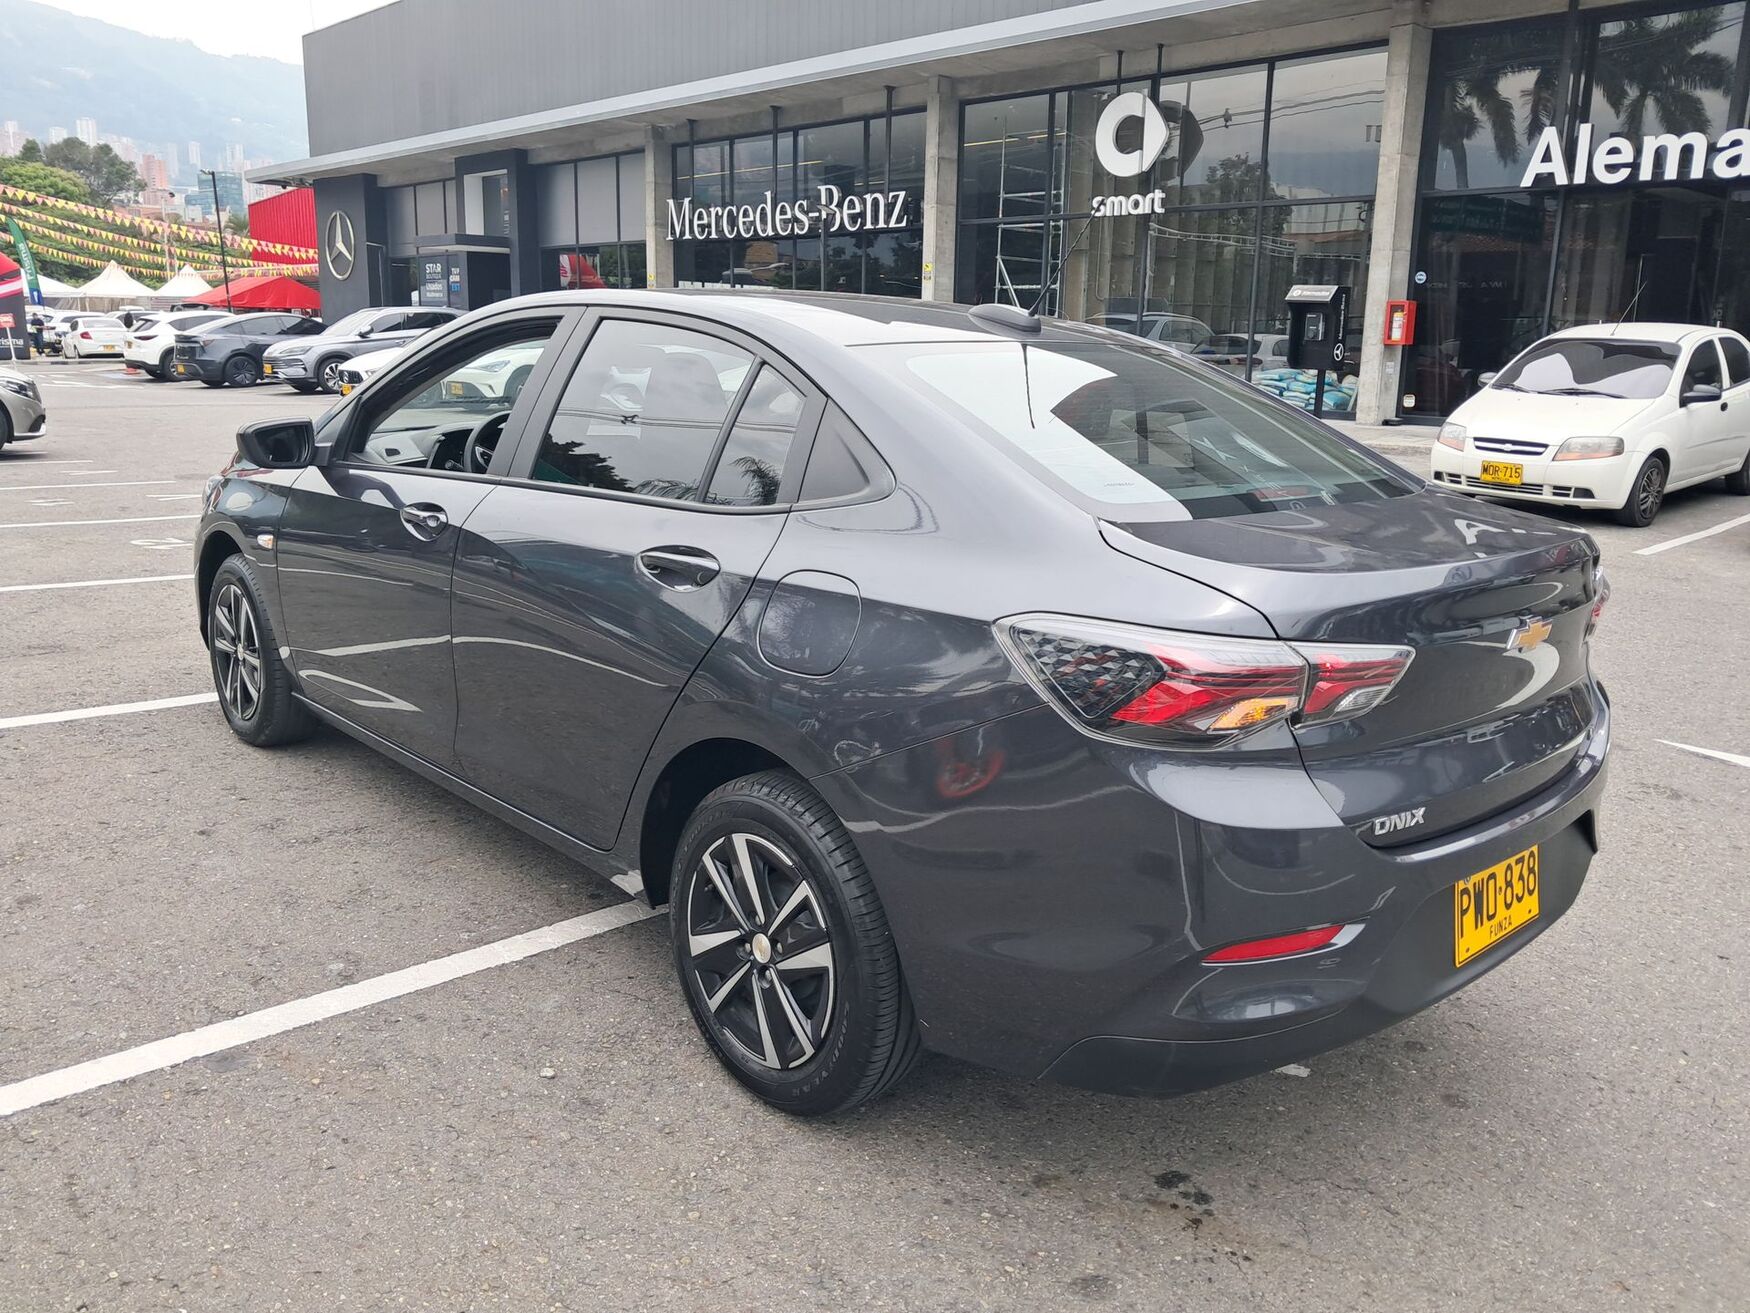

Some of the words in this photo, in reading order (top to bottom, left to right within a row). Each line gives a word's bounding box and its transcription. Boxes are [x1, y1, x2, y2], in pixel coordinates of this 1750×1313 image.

[1520, 123, 1750, 188] Alema
[665, 184, 908, 241] Mercedes-Benz
[1090, 188, 1167, 217] smart
[425, 264, 442, 273] STAR
[1373, 806, 1426, 837] ONIX
[1489, 916, 1513, 940] FUNZA
